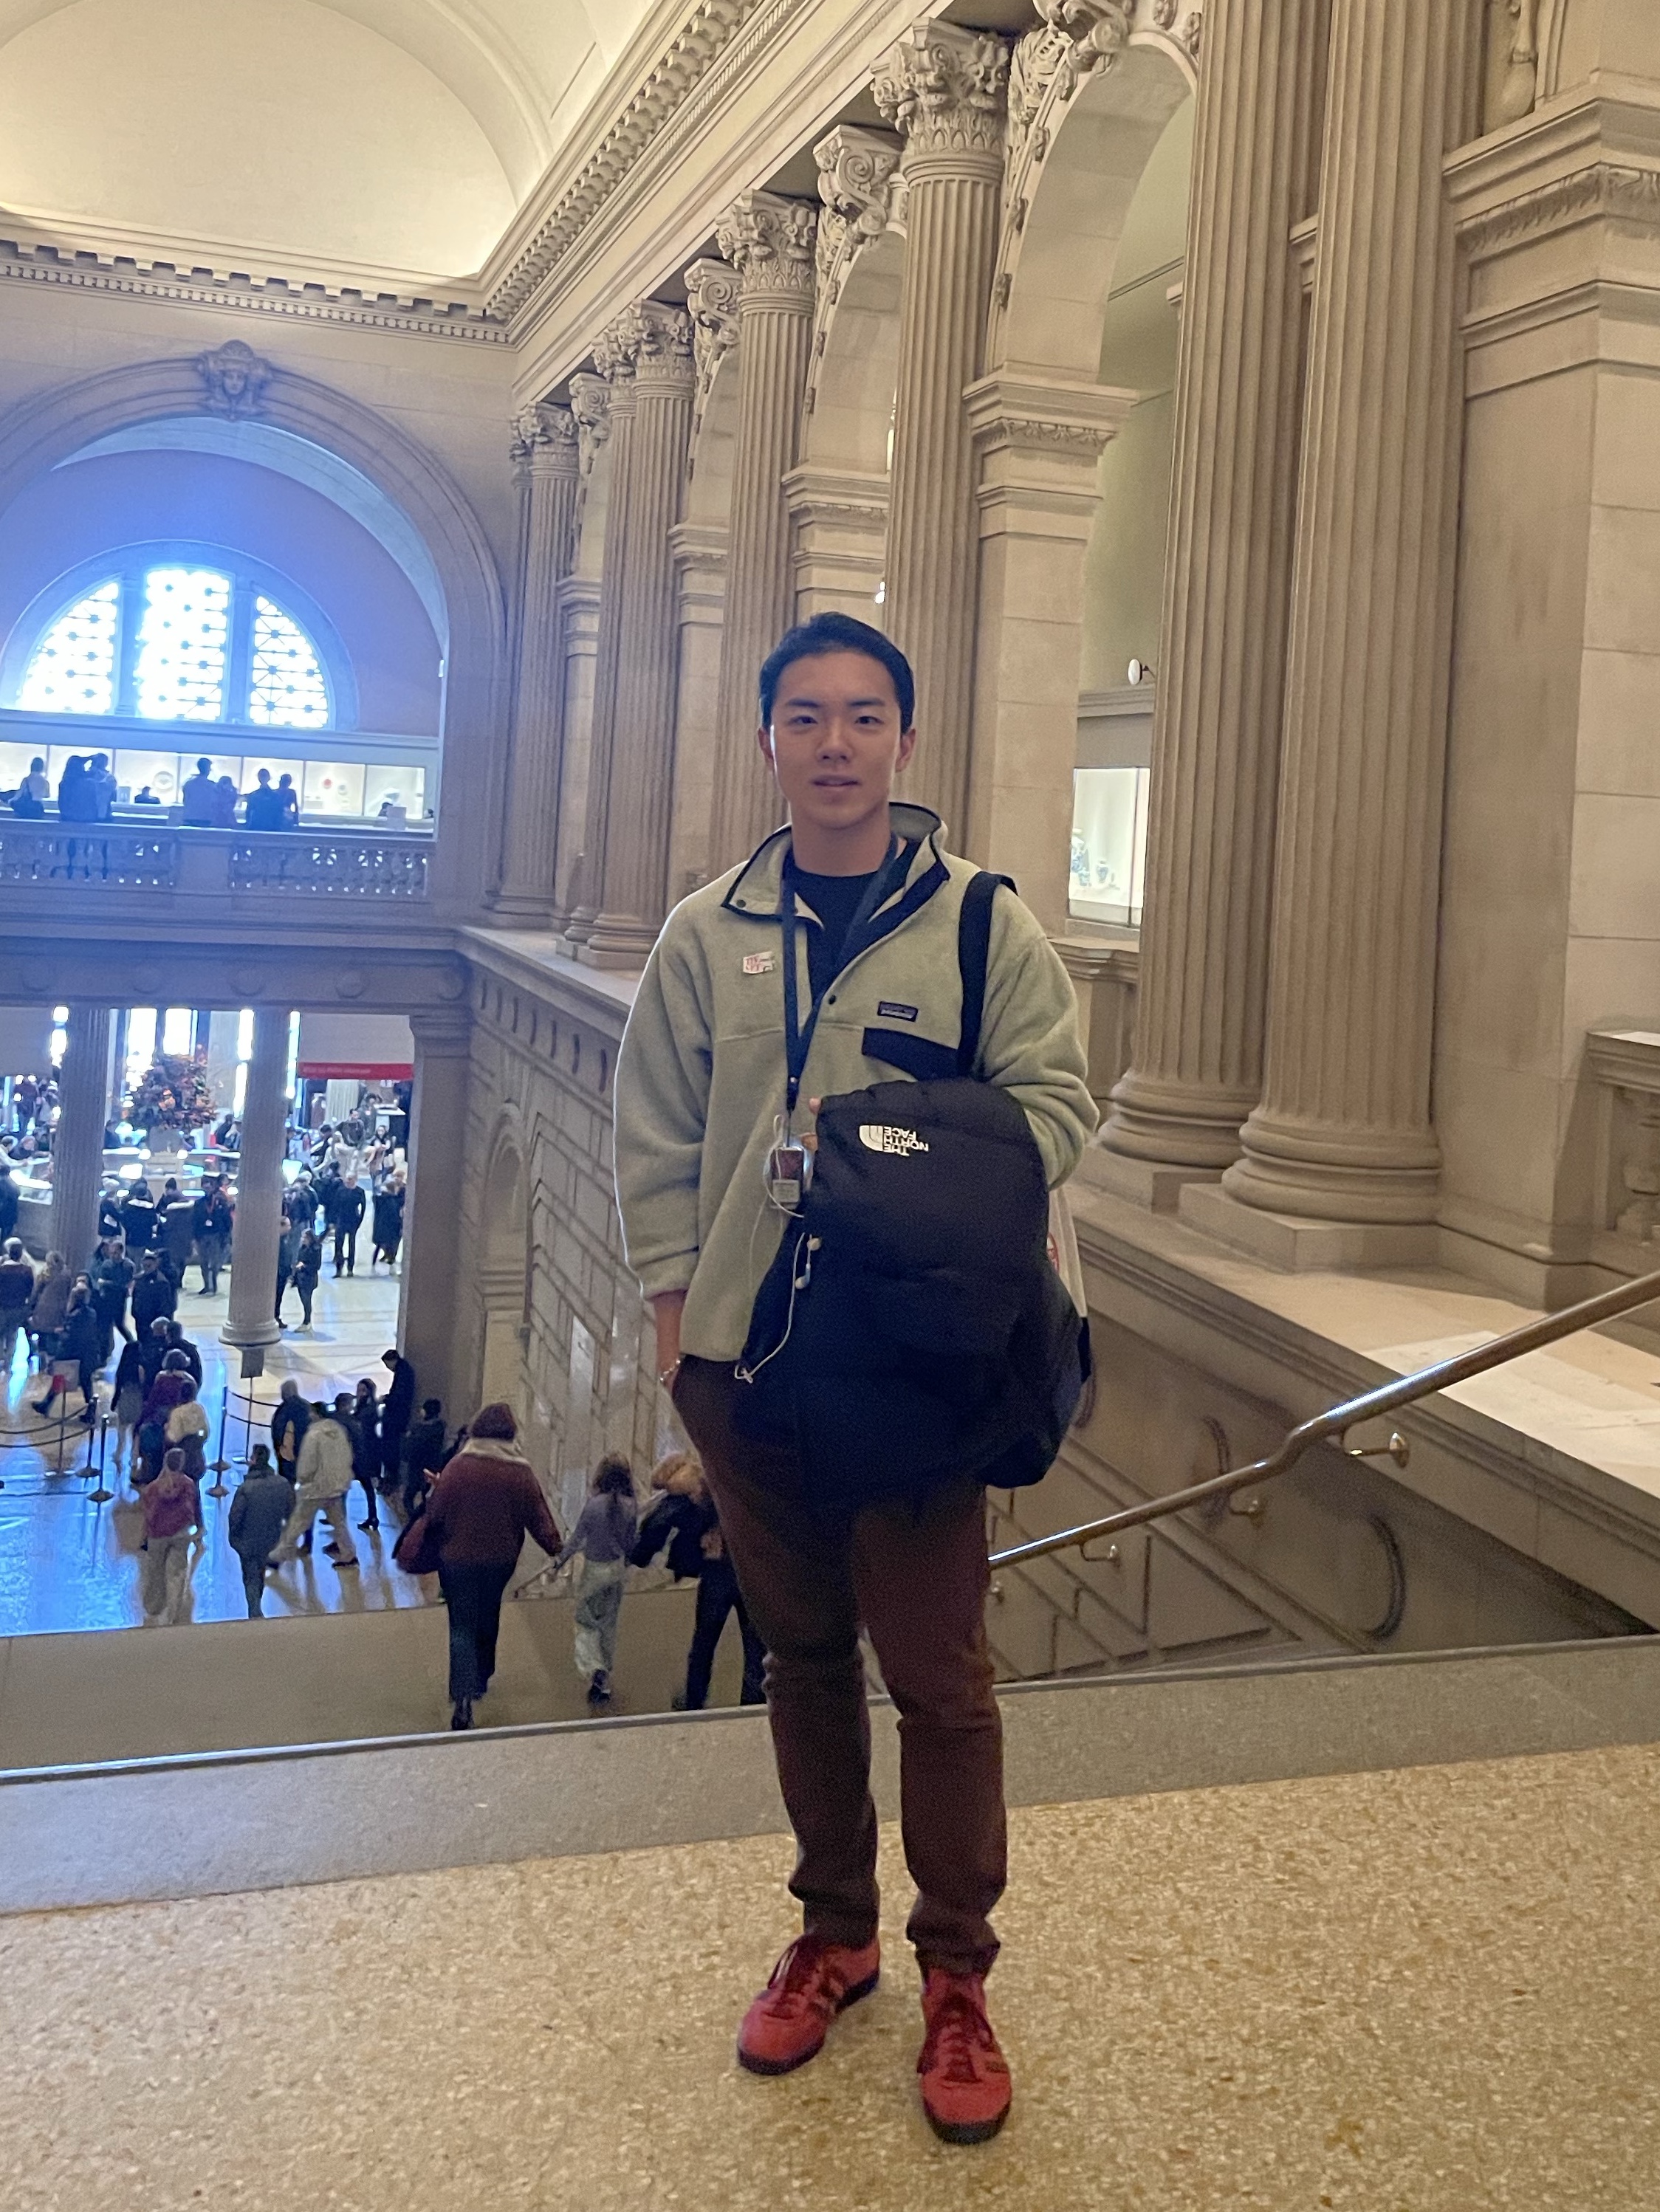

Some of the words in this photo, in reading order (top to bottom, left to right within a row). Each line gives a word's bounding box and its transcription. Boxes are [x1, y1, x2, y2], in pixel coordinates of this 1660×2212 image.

[883, 1126, 916, 1140] FACE
[883, 1143, 909, 1156] THE
[884, 1134, 929, 1151] NORTH
